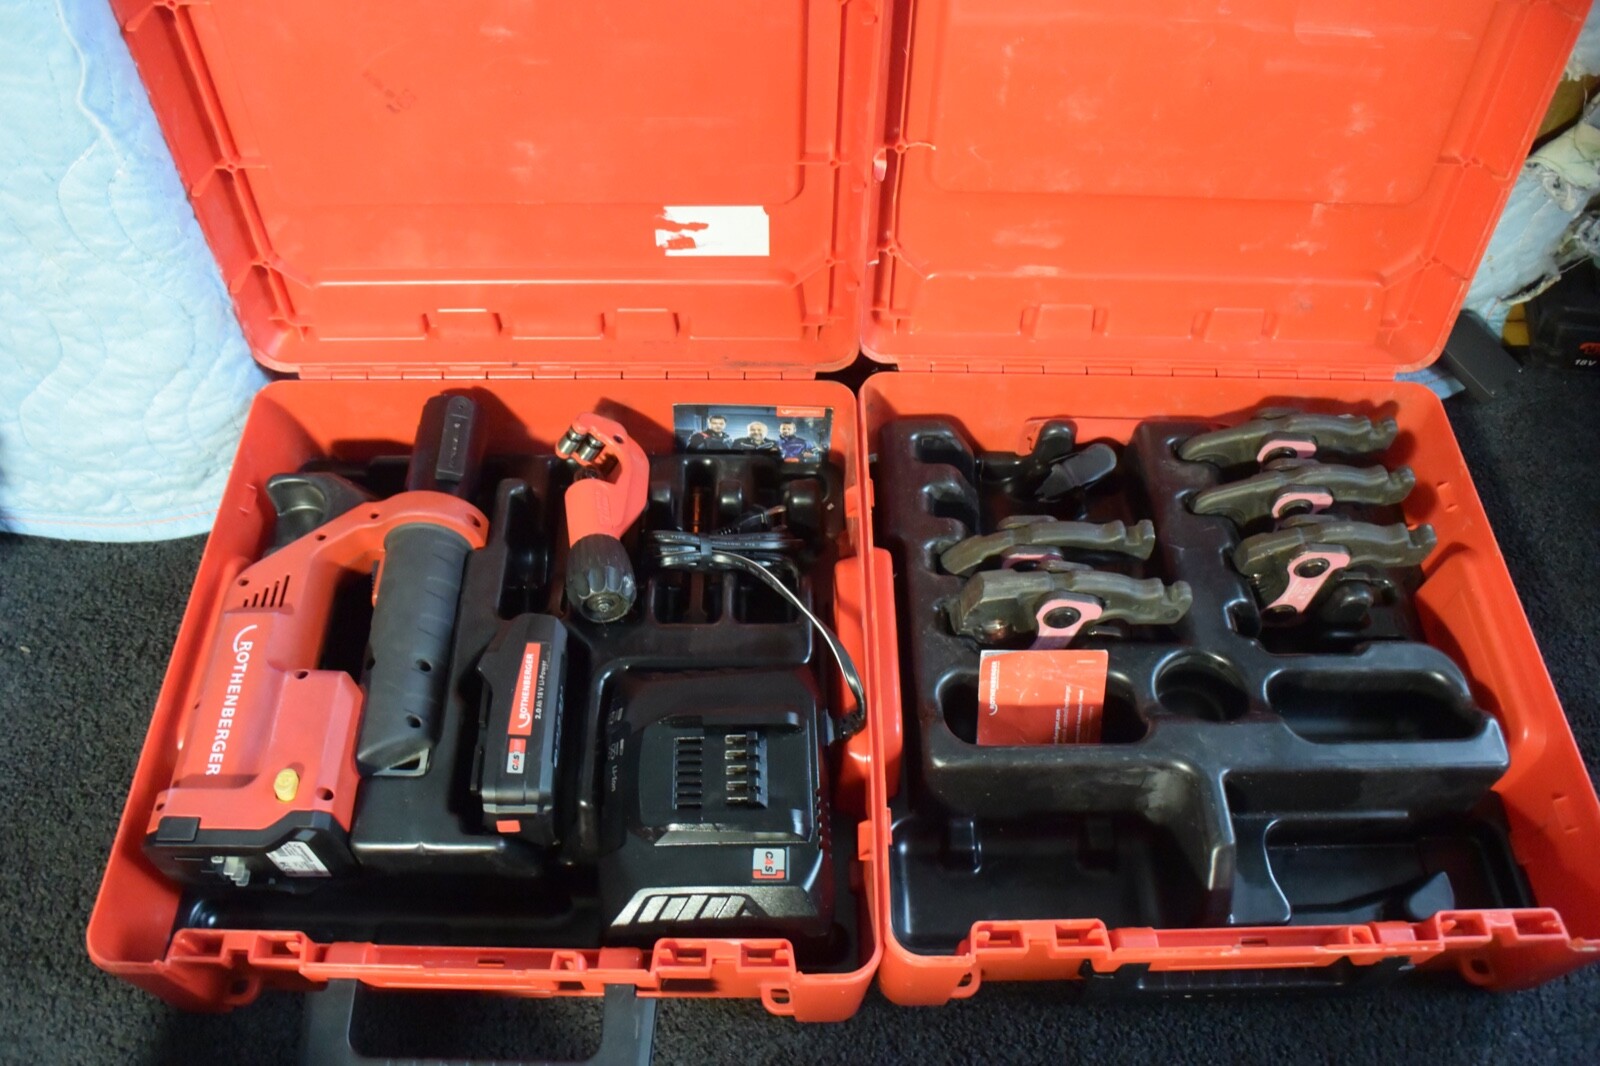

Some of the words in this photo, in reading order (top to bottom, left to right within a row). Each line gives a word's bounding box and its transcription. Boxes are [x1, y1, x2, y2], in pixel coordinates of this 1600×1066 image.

[205, 624, 258, 776] ROTHENBERGER
[517, 653, 534, 728] ROTHENBERGER
[536, 699, 543, 708] Ah
[534, 708, 542, 720] 2.0
[511, 754, 520, 771] CAS
[764, 851, 774, 873] CAS
